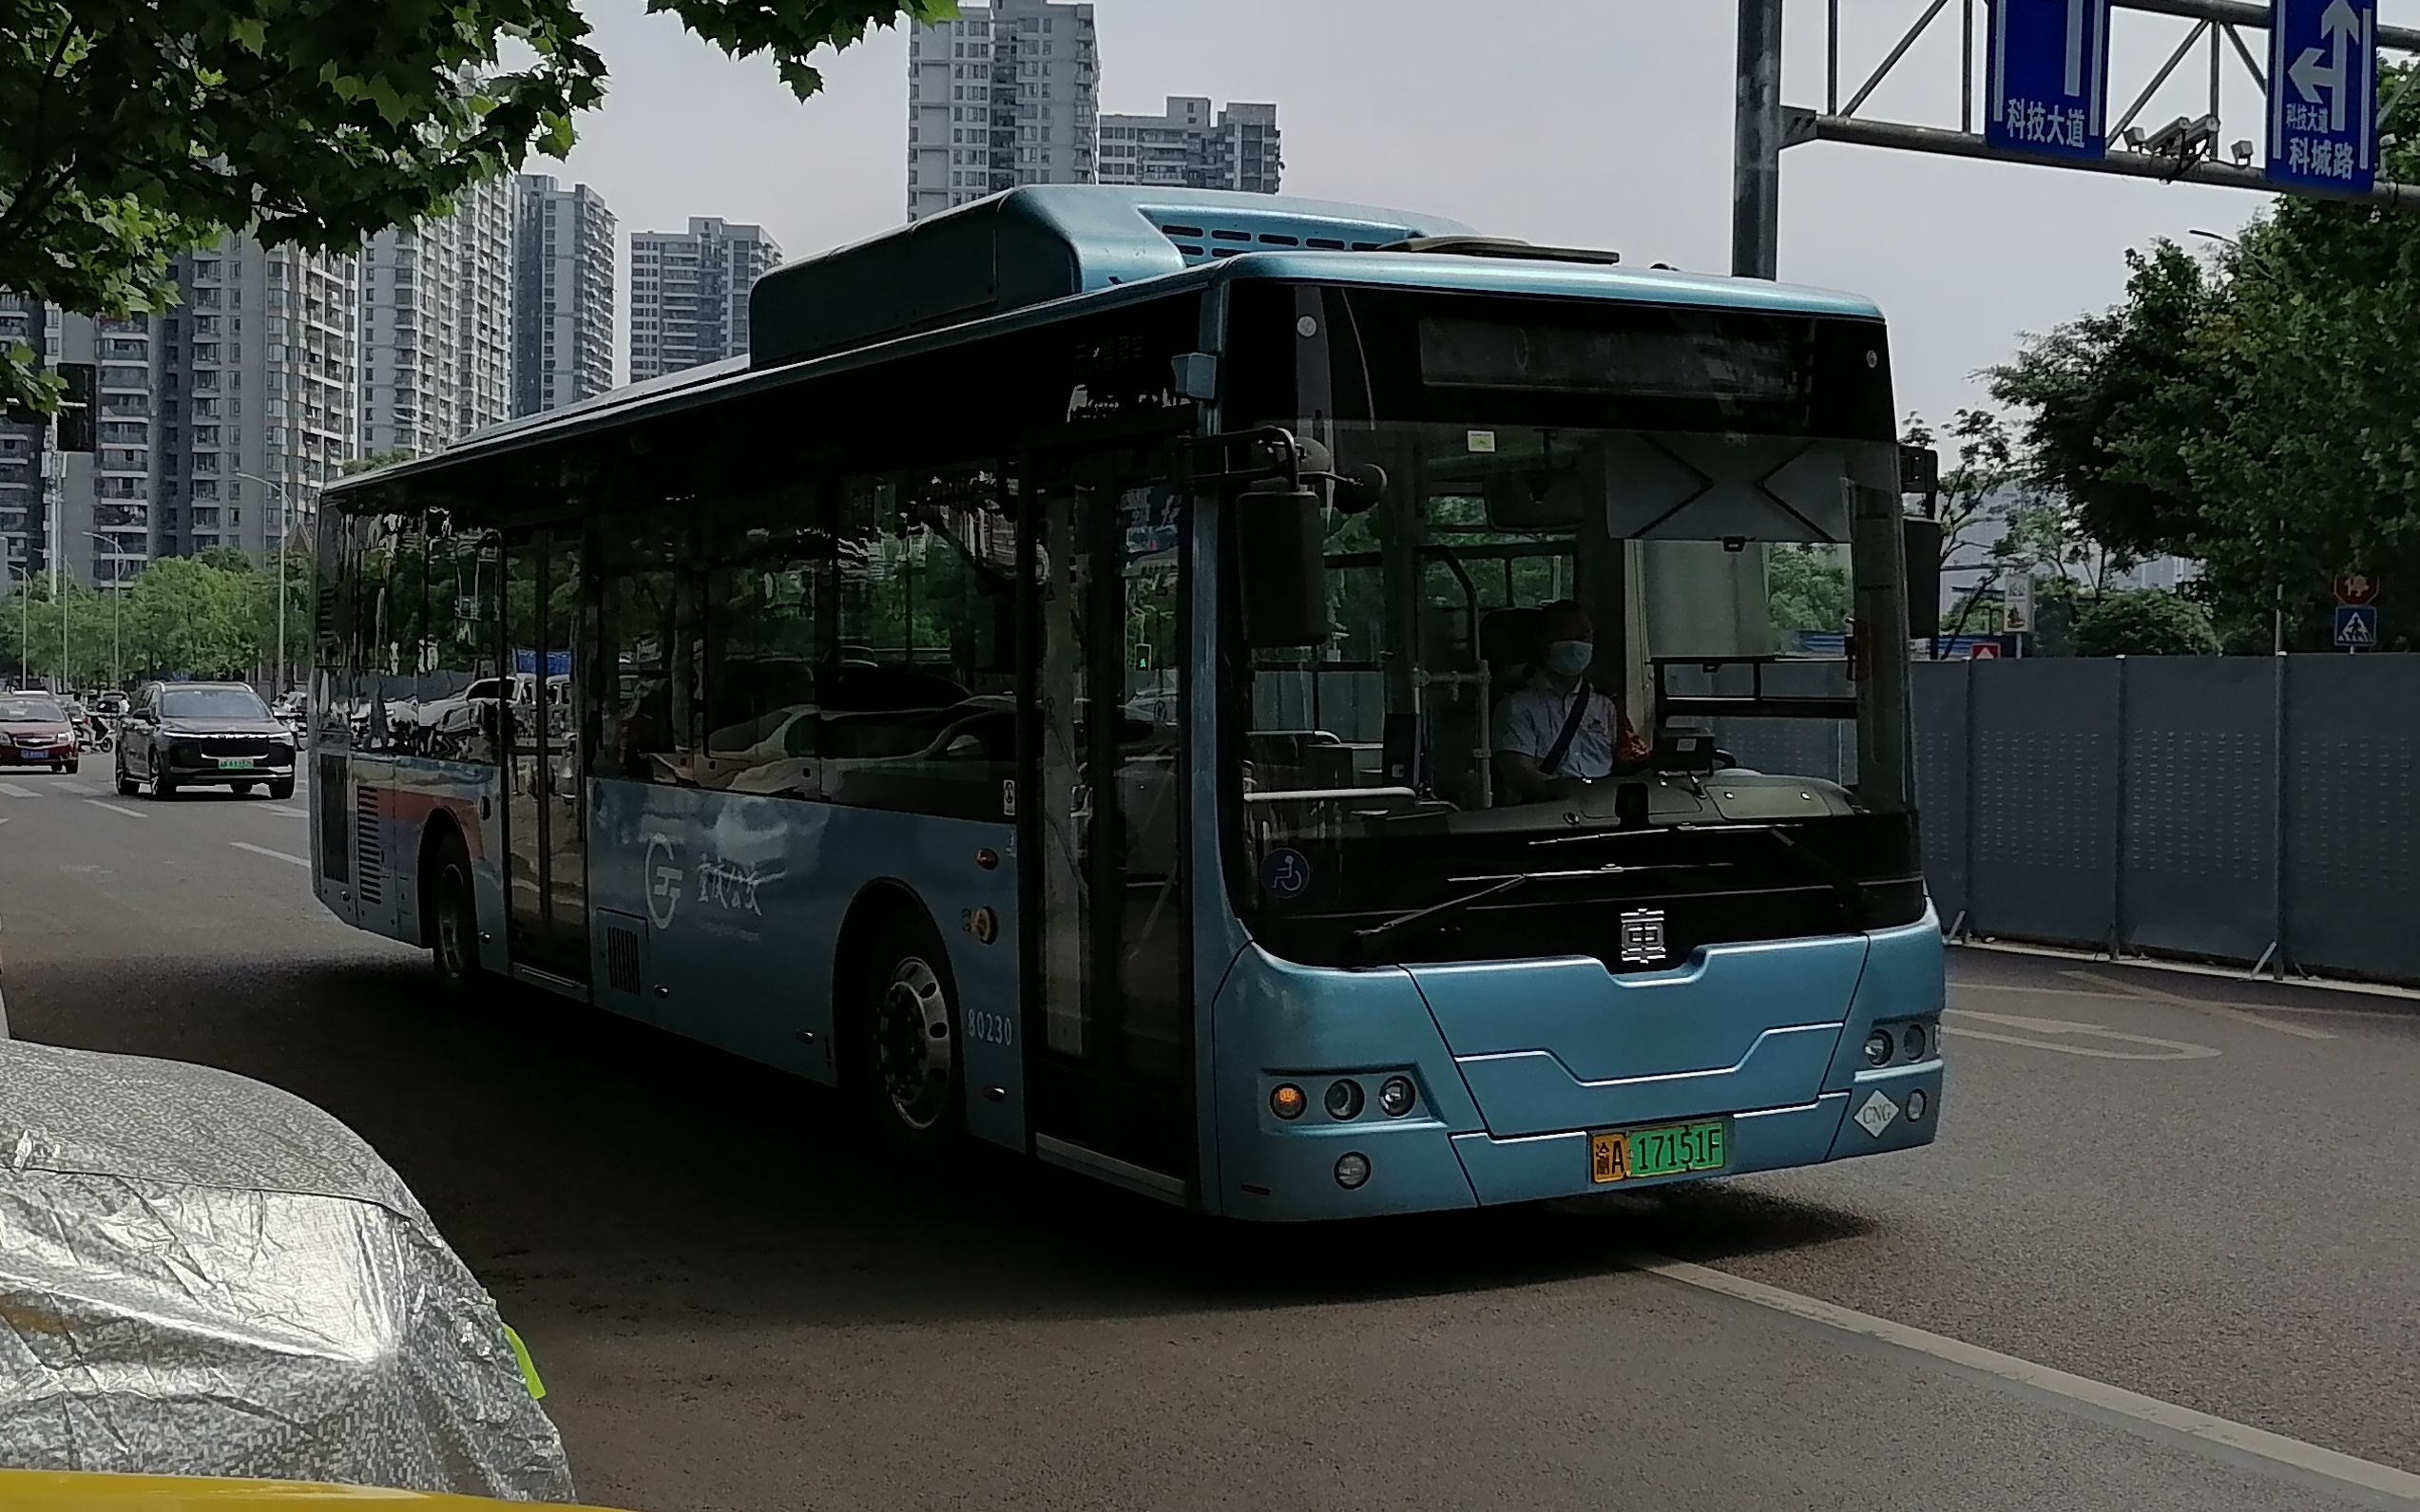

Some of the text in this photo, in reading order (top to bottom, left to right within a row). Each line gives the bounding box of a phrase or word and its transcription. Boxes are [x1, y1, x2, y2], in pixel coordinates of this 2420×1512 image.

[2007, 98, 2085, 148] 科技大道
[2286, 103, 2329, 134] 科技大道
[2288, 137, 2354, 181] 科城路
[968, 1008, 1012, 1046] 80230
[1863, 1102, 1892, 1124] CNG
